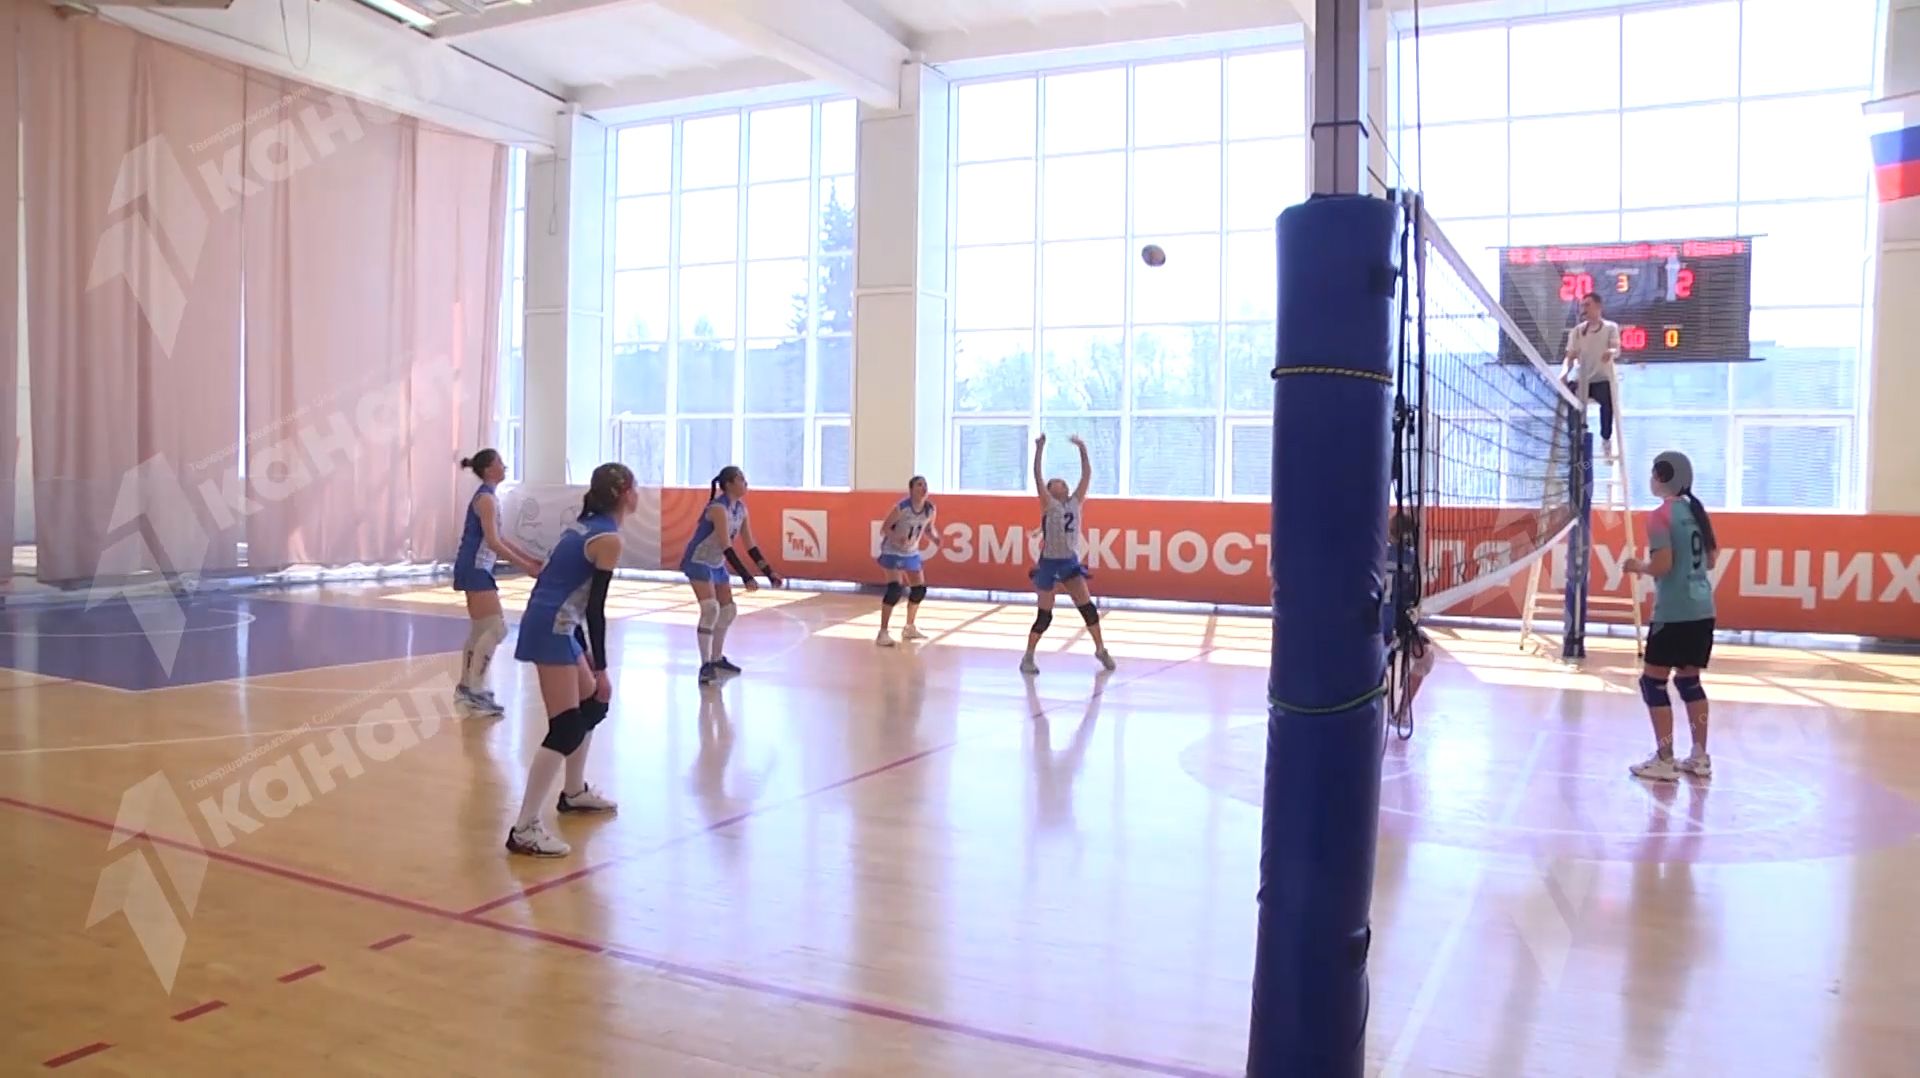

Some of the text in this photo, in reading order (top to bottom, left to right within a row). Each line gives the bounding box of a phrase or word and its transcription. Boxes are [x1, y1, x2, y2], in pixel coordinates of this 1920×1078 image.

[1615, 274, 1629, 293] 3
[1064, 512, 1075, 533] 2
[785, 531, 814, 558] ТМК
[870, 519, 1272, 577] ЗМЖНОС
[1691, 529, 1703, 571] 9
